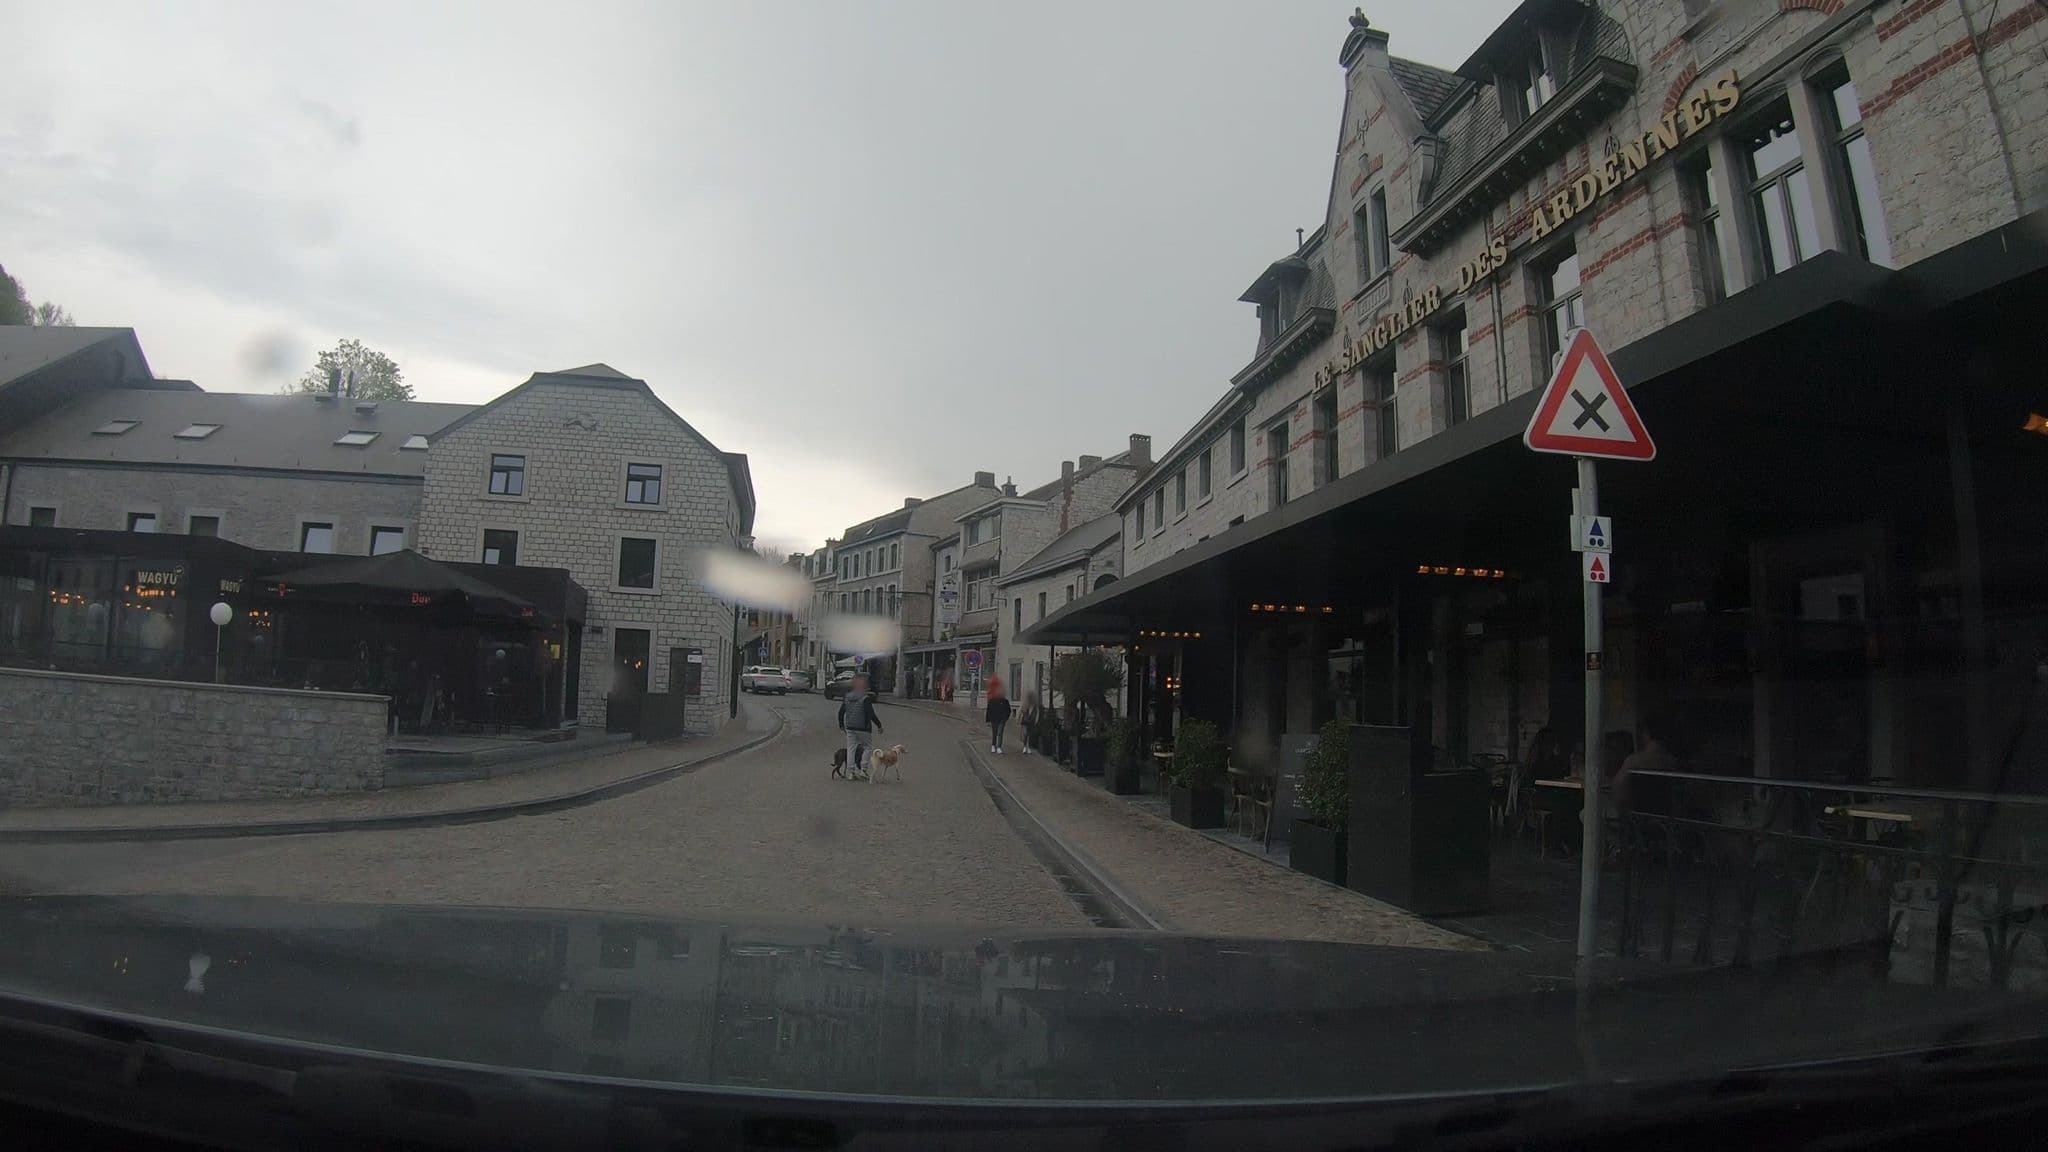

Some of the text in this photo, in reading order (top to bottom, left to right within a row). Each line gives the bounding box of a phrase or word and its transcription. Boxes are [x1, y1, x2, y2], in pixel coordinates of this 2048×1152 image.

[1312, 68, 1740, 394] LE SANGLIER DES ARDENNES
[138, 571, 178, 585] WAGYU
